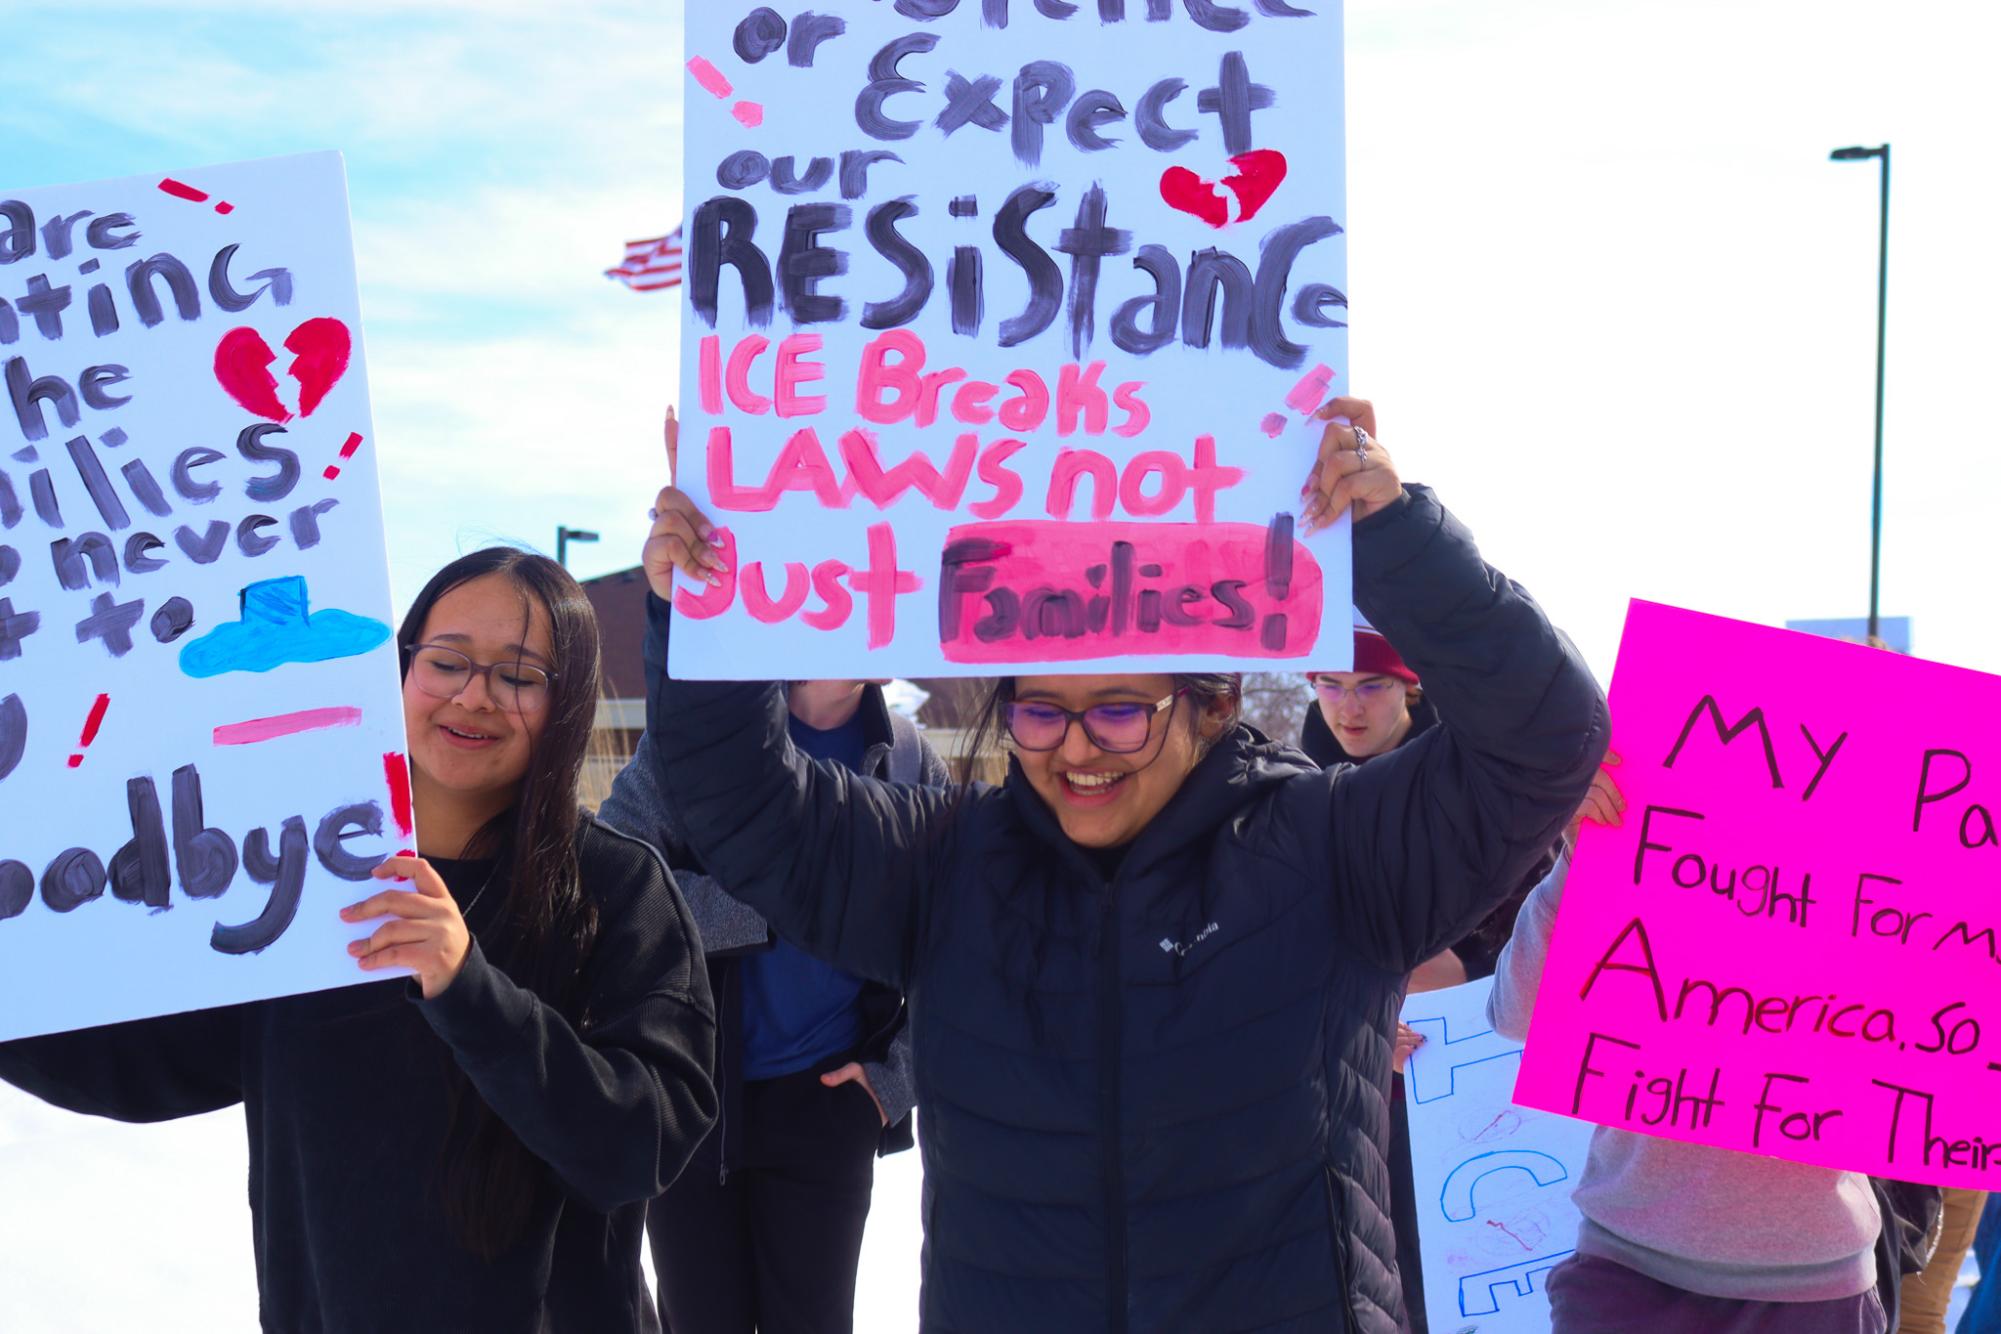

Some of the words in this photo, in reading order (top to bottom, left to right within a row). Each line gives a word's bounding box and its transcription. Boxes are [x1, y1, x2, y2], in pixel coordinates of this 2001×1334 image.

[733, 6, 846, 67] or
[717, 150, 906, 200] our
[3, 355, 134, 441] he
[698, 334, 827, 418] ICE
[0, 423, 301, 531] ilies
[1046, 433, 1247, 521] not
[51, 498, 340, 592] never
[674, 520, 924, 650] Just
[76, 591, 196, 657] to
[1633, 804, 1817, 928] Fought
[1852, 873, 1933, 945] For
[1571, 1032, 1726, 1130] Fight
[1753, 1073, 1844, 1148] For
[1871, 1078, 2001, 1171] Their
